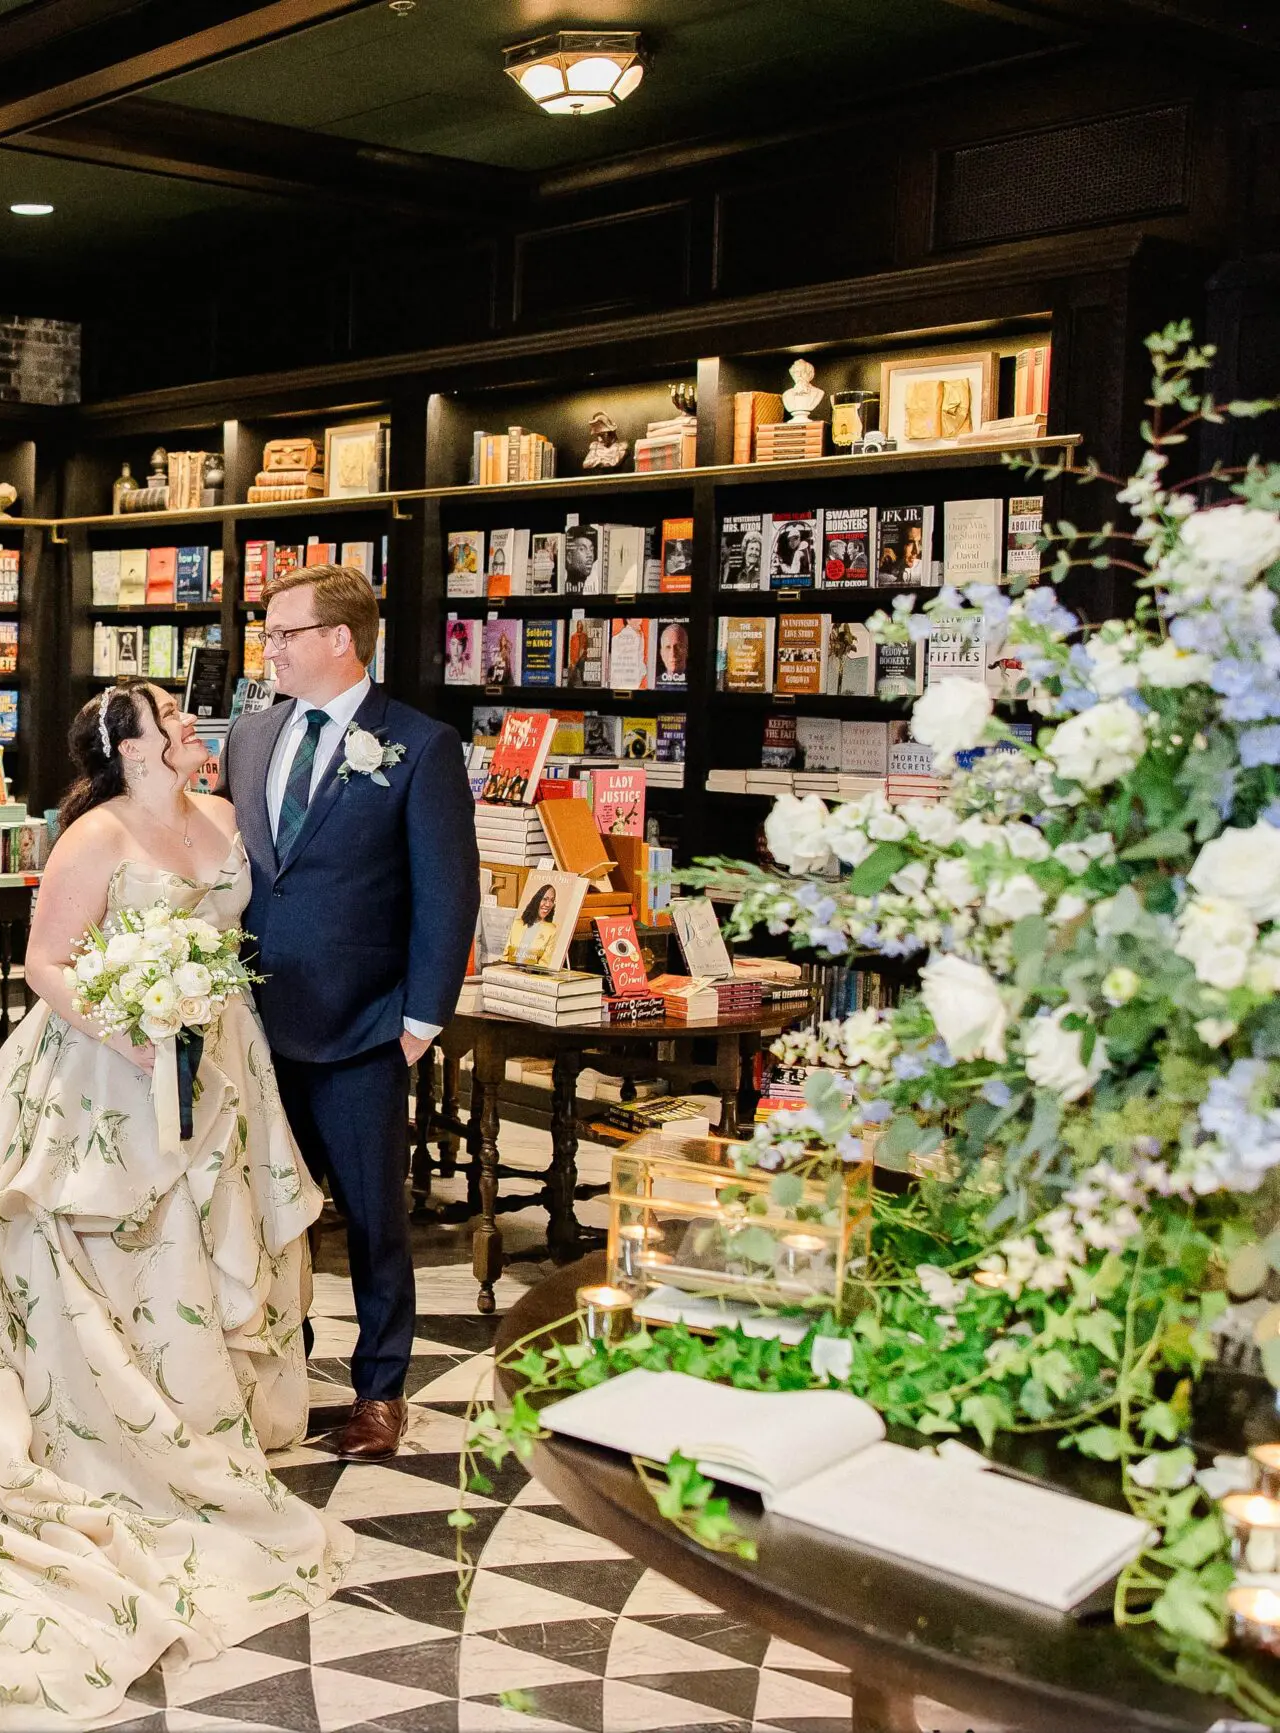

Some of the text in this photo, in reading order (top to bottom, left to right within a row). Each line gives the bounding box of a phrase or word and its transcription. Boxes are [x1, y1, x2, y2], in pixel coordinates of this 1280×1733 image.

[825, 508, 868, 520] SWAMP
[881, 508, 922, 523] JFK JR.
[723, 522, 761, 532] MRS. NIXON
[825, 519, 868, 531] MONSTERS
[955, 550, 980, 560] David
[946, 560, 990, 569] Leonhardt
[565, 580, 597, 593] RuPaul
[739, 623, 752, 632] THE
[728, 630, 764, 639] EXPLORERS
[532, 638, 553, 648] KINGS
[879, 655, 902, 665] BOOKER
[929, 650, 981, 663] FIFTIES
[892, 753, 931, 764] MORTAL
[890, 762, 932, 772] SECRETS
[608, 775, 633, 788] LADY
[599, 790, 641, 804] JUSTICE
[604, 924, 632, 938] 1984
[612, 958, 640, 976] George
[618, 972, 646, 987] Orwell
[771, 987, 810, 1000] THE CLEOPATRAS
[614, 1000, 630, 1010] 1984
[616, 1010, 631, 1020] 1984
